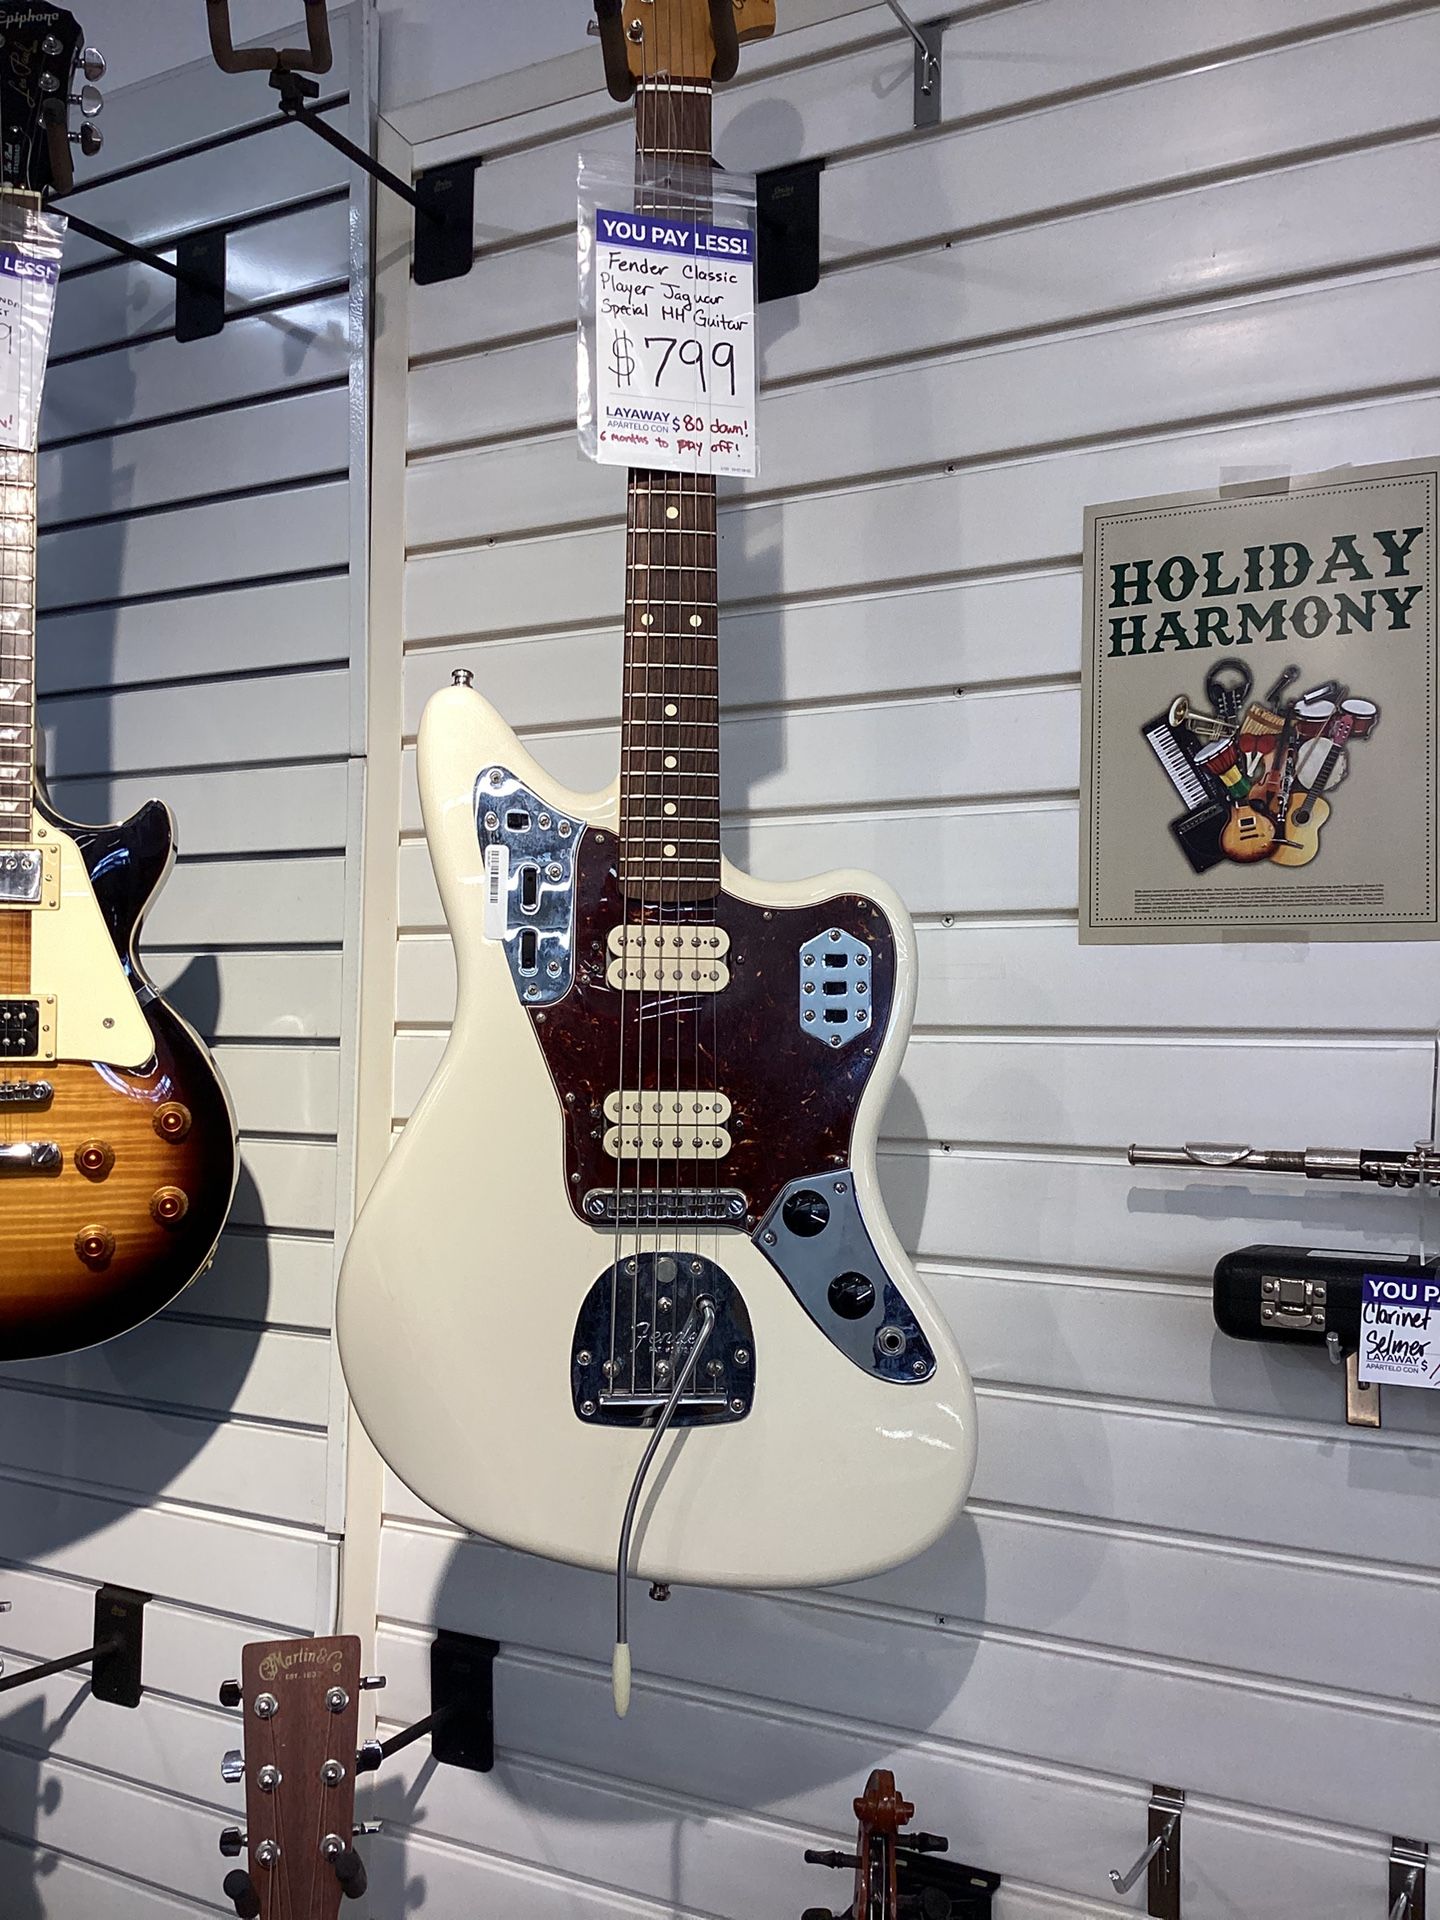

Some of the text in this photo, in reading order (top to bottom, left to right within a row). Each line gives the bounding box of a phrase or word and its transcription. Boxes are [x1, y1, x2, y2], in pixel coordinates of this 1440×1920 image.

[603, 219, 748, 255] YOU PAY LESS!
[609, 252, 738, 284] Fender Classic
[600, 272, 724, 311] Player Jaguar
[601, 298, 748, 331] Special HH Guitar
[608, 328, 736, 396] $799
[606, 406, 670, 422] LAYAWAY
[710, 418, 749, 437] down!
[651, 425, 669, 433] CON
[600, 431, 606, 441] 6
[611, 432, 649, 445] months
[655, 437, 669, 448] to
[711, 440, 741, 457] off!
[1108, 527, 1424, 608] HOLIDAY
[1107, 585, 1424, 658] HARMONY
[1368, 1280, 1417, 1301] YOU
[1363, 1301, 1432, 1330] Clarinet
[630, 1318, 698, 1352] Fende
[1366, 1330, 1431, 1357] Selmer
[1366, 1351, 1419, 1365] LAYAWAY
[1403, 1366, 1419, 1374] CON
